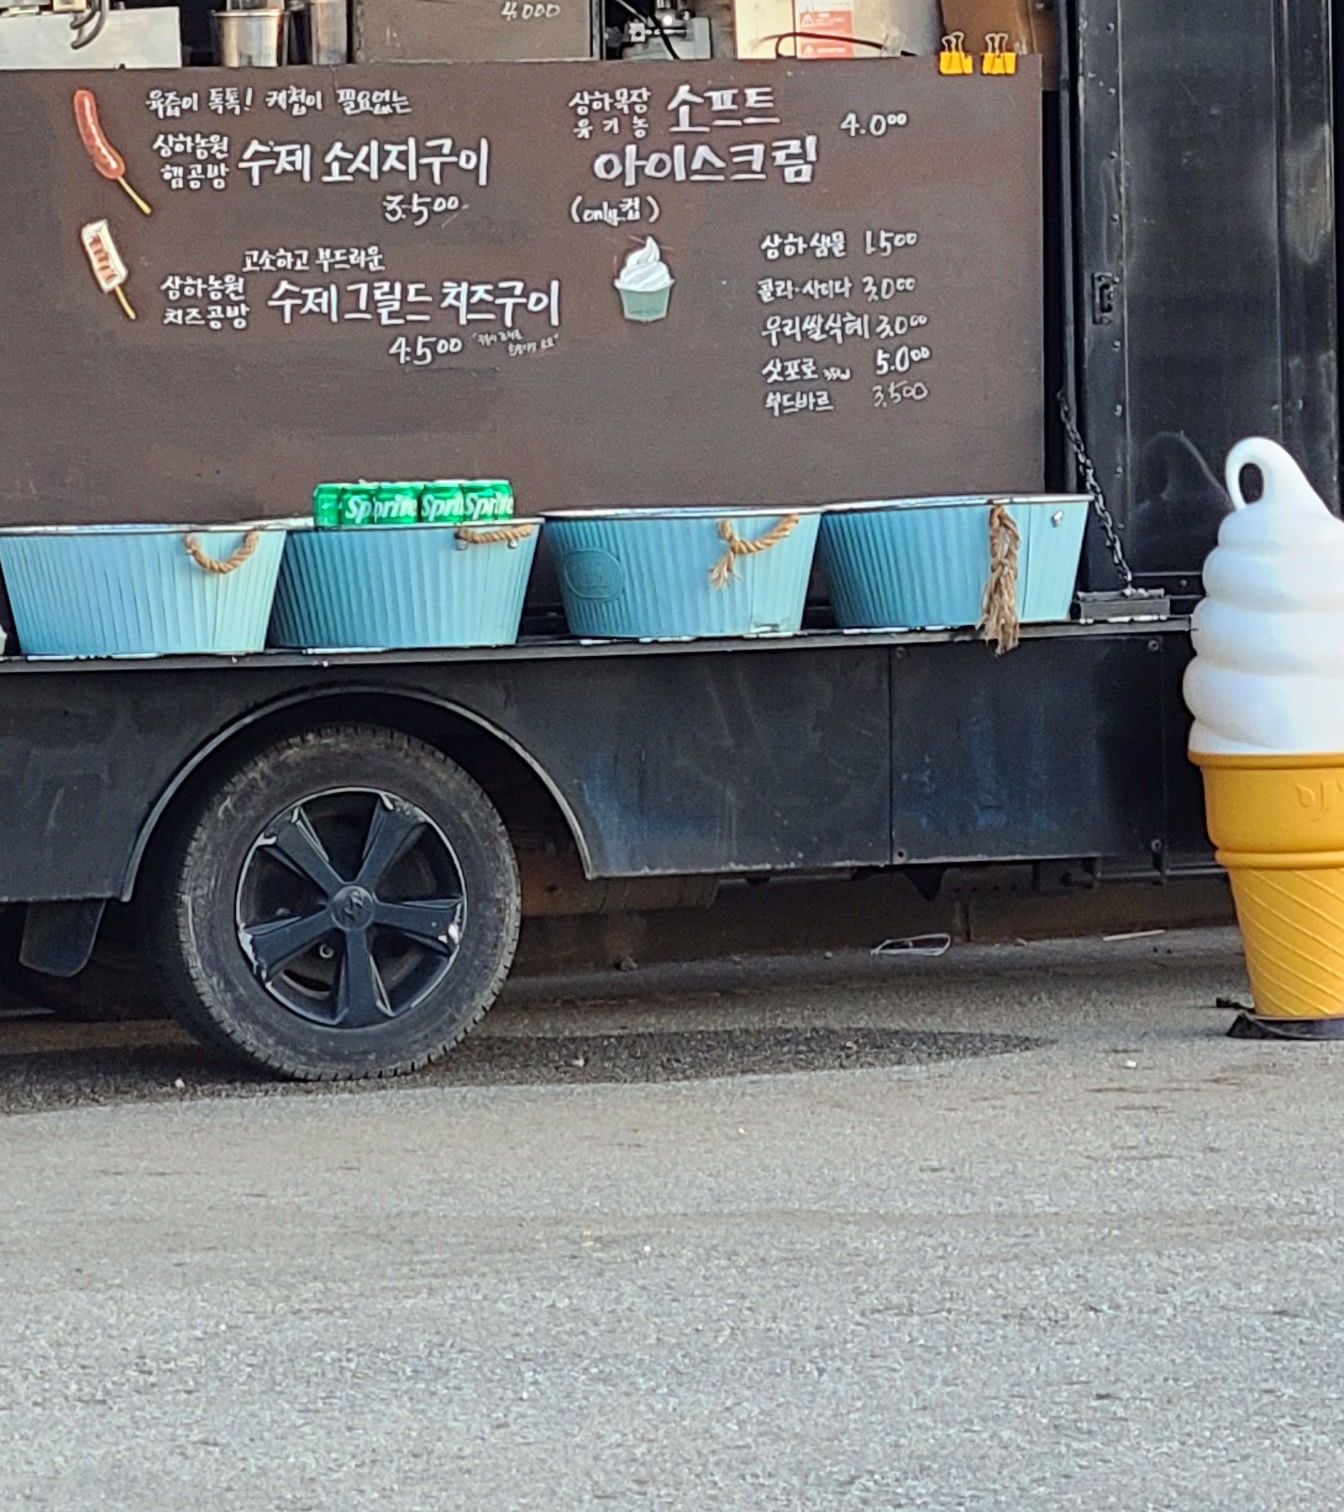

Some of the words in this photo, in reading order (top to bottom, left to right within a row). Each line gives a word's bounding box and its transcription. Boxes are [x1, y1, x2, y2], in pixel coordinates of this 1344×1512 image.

[146, 90, 199, 119] 육즙이
[336, 88, 412, 116] 필요없는
[567, 86, 652, 116] 상하목장
[667, 84, 781, 133] 소프트
[152, 134, 230, 159] 상하농원
[237, 139, 312, 187] 수제
[321, 136, 490, 186] 소시지구이
[593, 134, 818, 187] 아이스크림
[241, 248, 310, 273] 고소하고
[315, 245, 386, 273] 부드러운
[160, 273, 246, 300] 상하농원
[267, 280, 339, 324] 수제
[343, 281, 433, 325] 그릴드
[439, 280, 561, 327] 치즈구이
[761, 357, 819, 384] 삿포로
